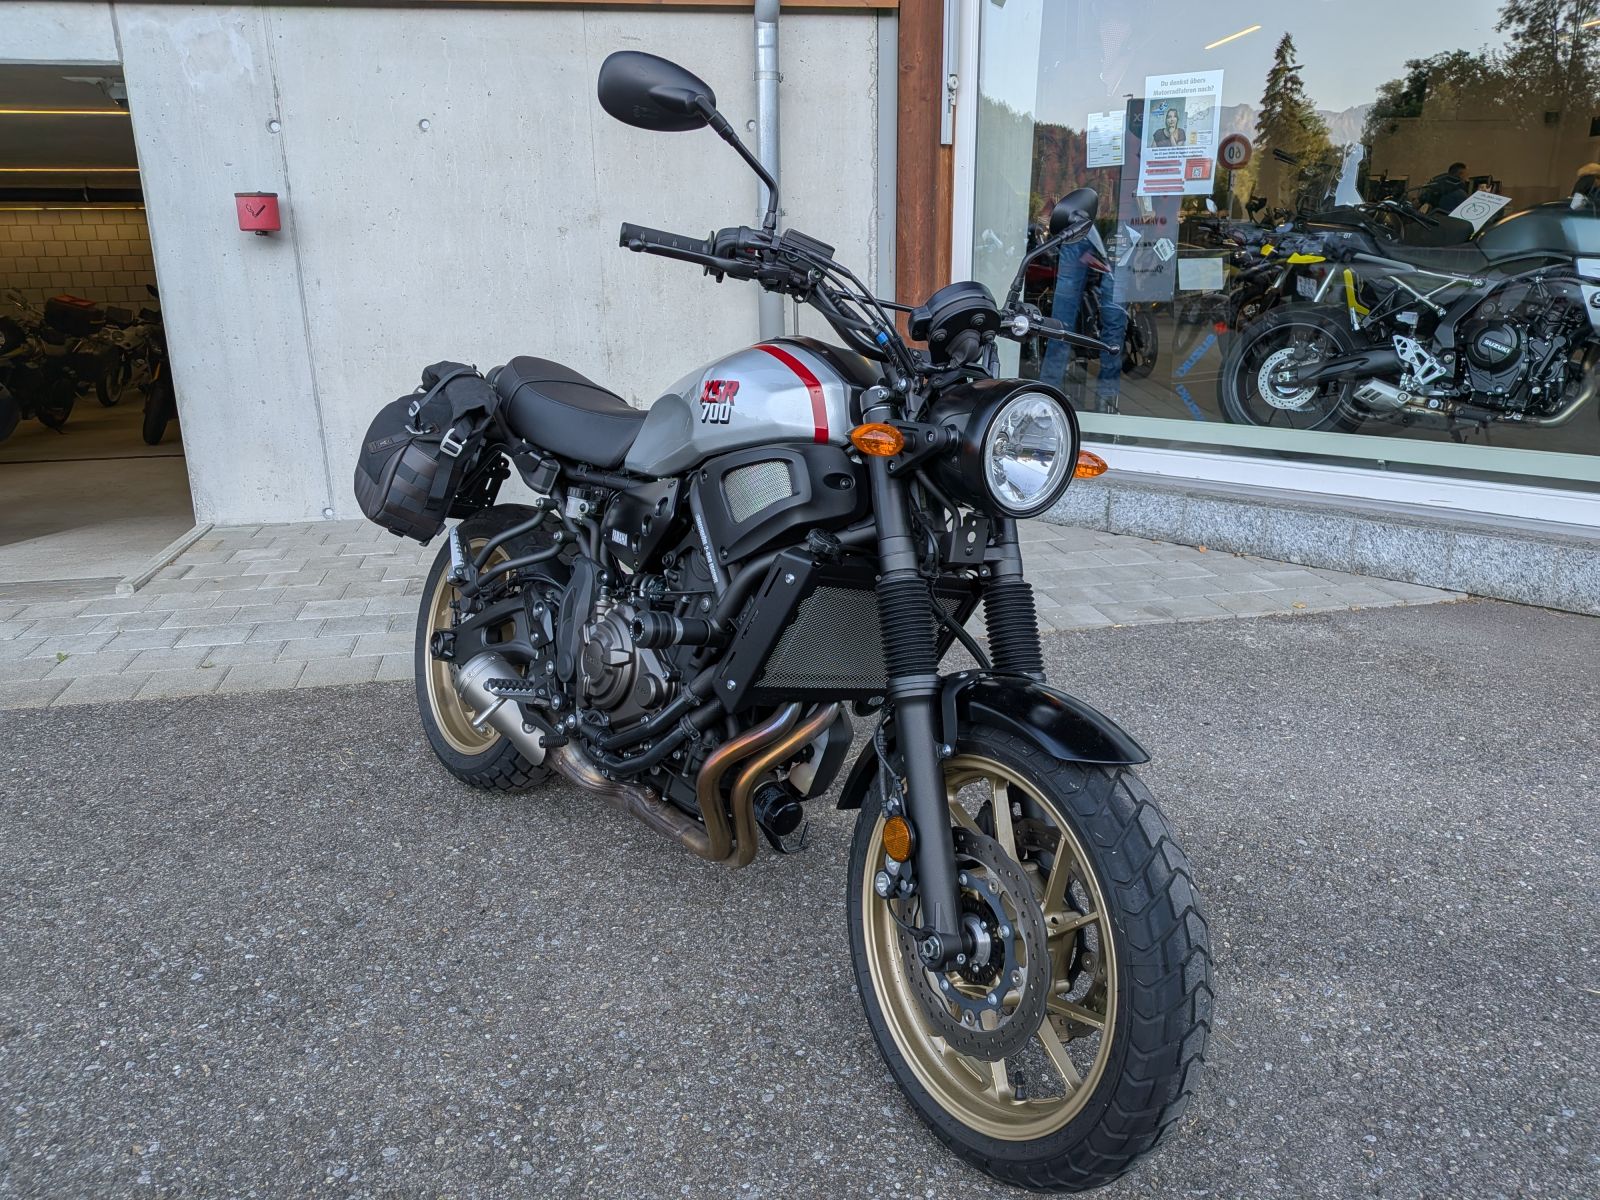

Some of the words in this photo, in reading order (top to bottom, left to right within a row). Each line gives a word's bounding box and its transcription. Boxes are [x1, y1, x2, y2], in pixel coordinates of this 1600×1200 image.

[1153, 87, 1197, 96] Motorradfahren
[1483, 339, 1511, 353] SUZUKI
[700, 380, 740, 406] XSR
[701, 403, 731, 424] 700
